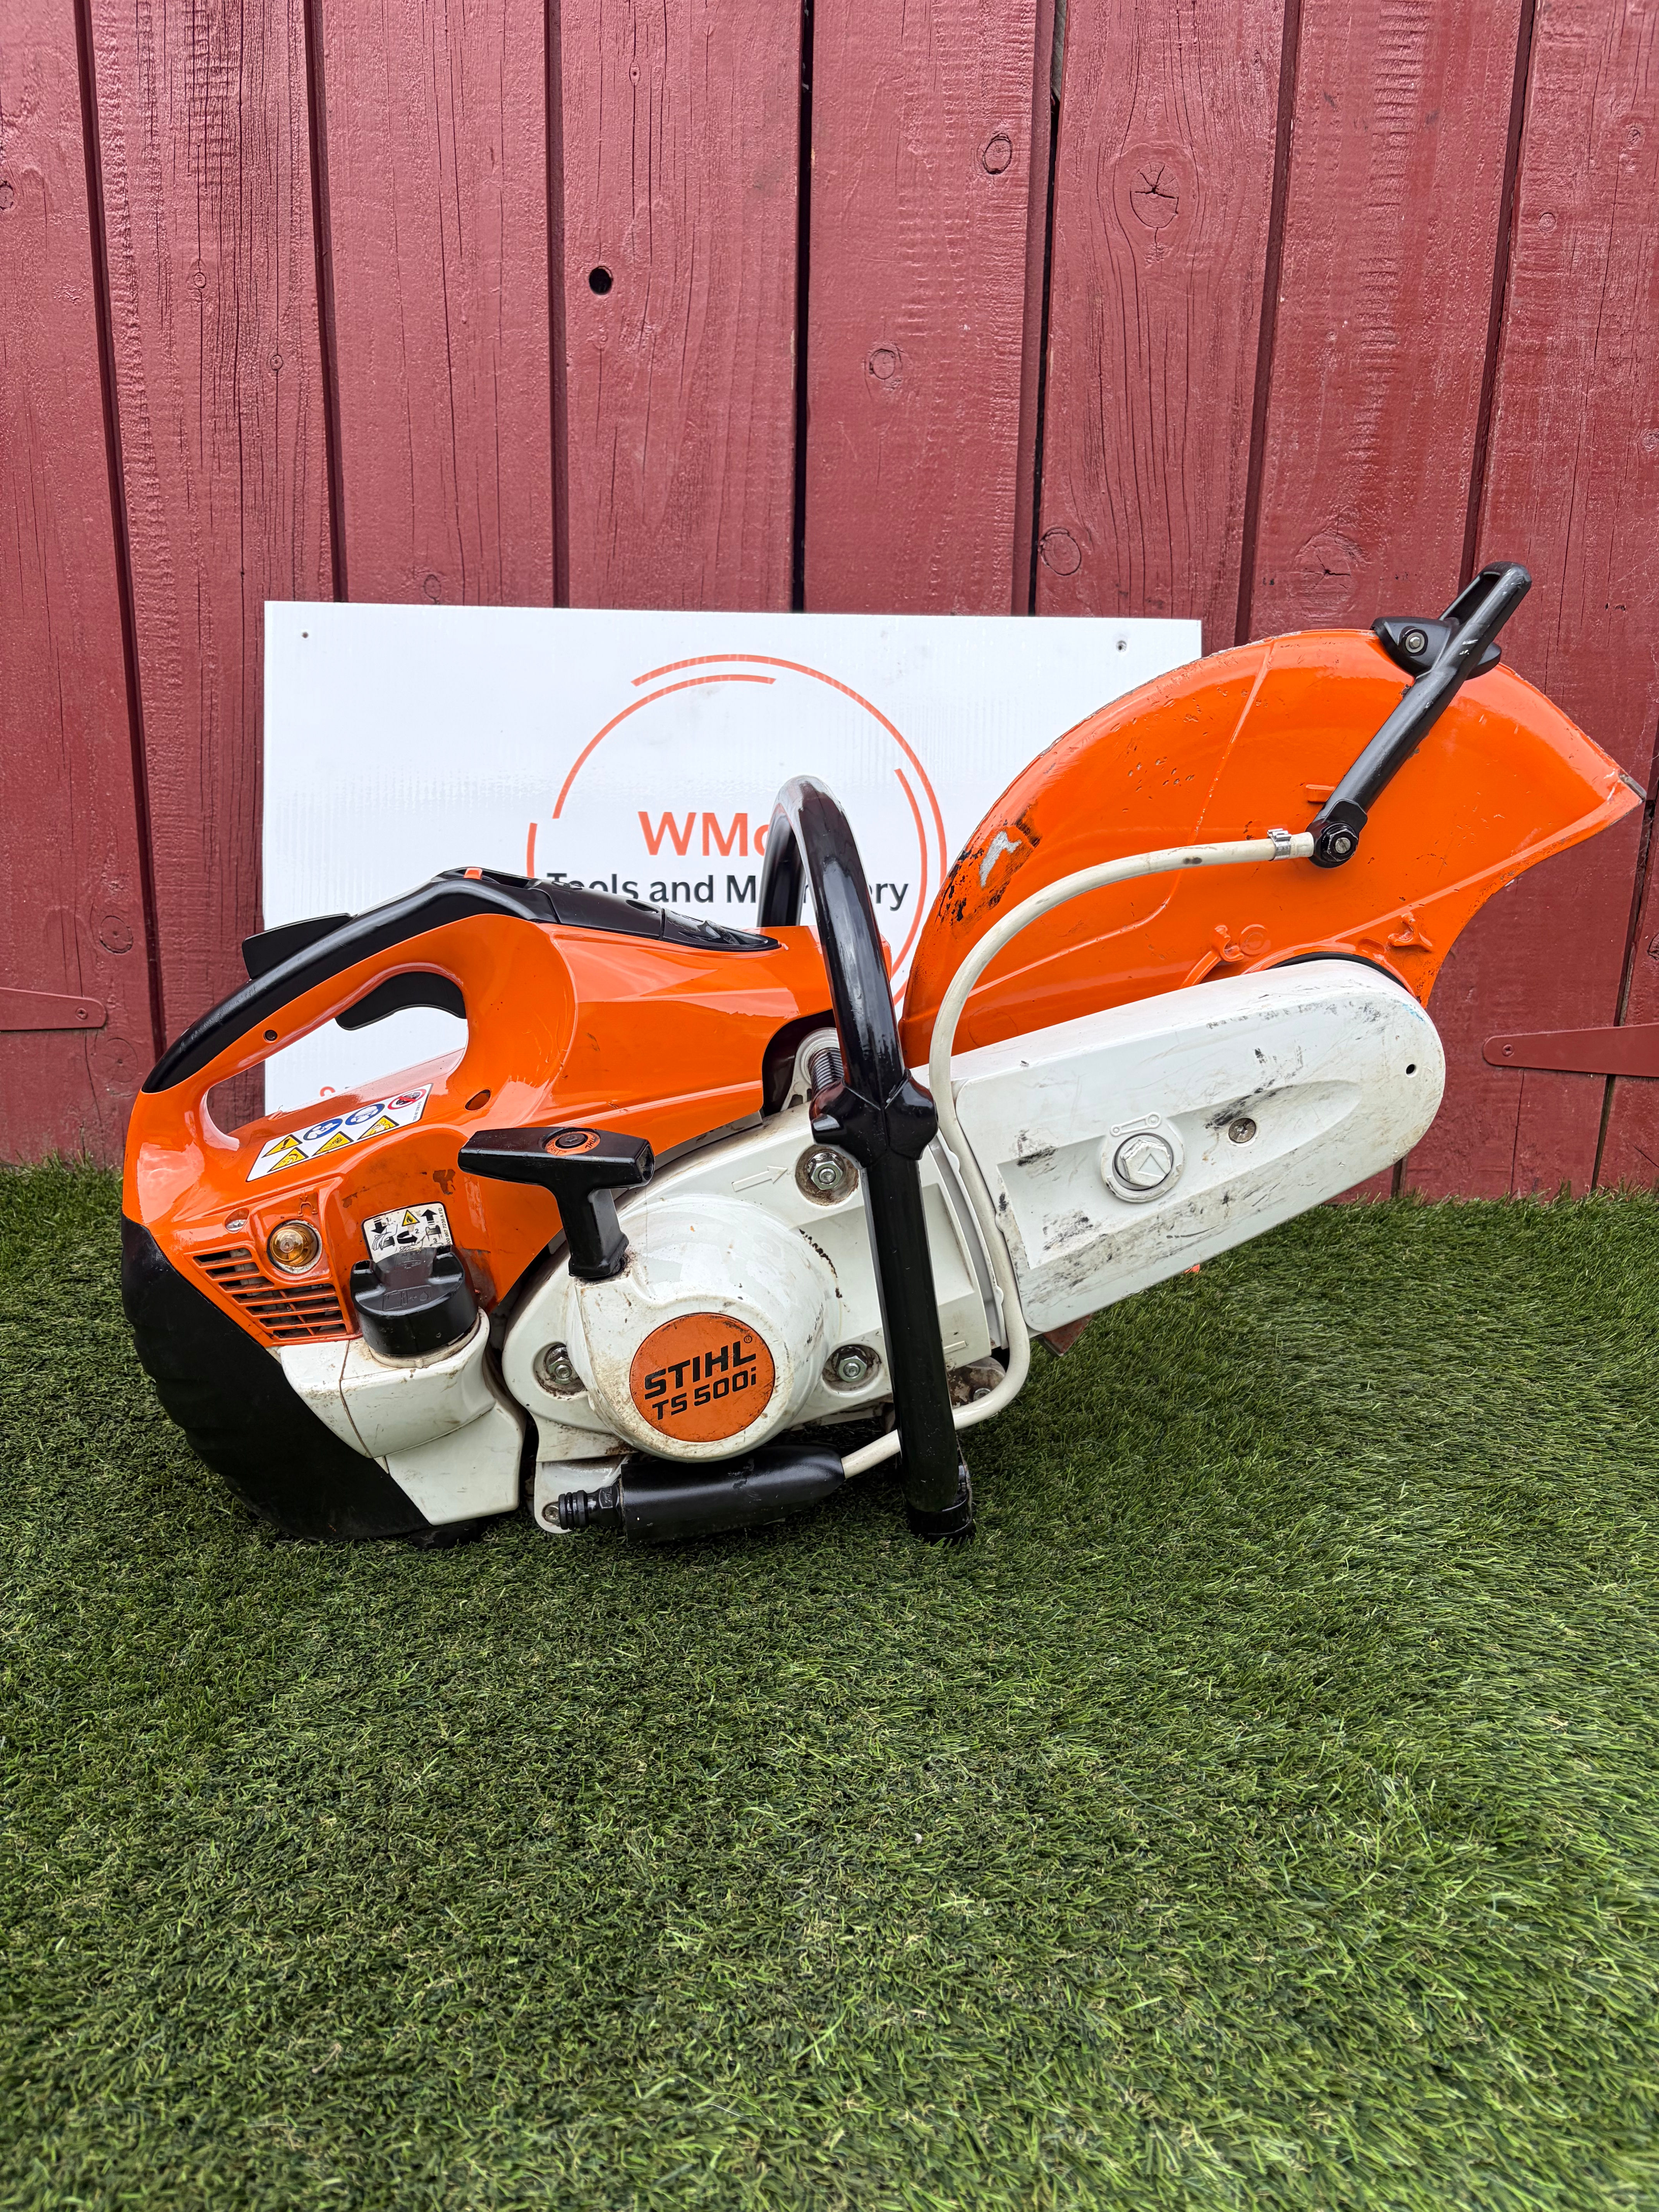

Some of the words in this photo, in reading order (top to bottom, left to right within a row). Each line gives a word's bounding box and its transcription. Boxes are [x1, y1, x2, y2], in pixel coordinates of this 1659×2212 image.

[649, 875, 714, 903] and
[644, 1340, 756, 1400] STIHL
[652, 1393, 687, 1420] TS
[694, 1366, 756, 1407] 500i
